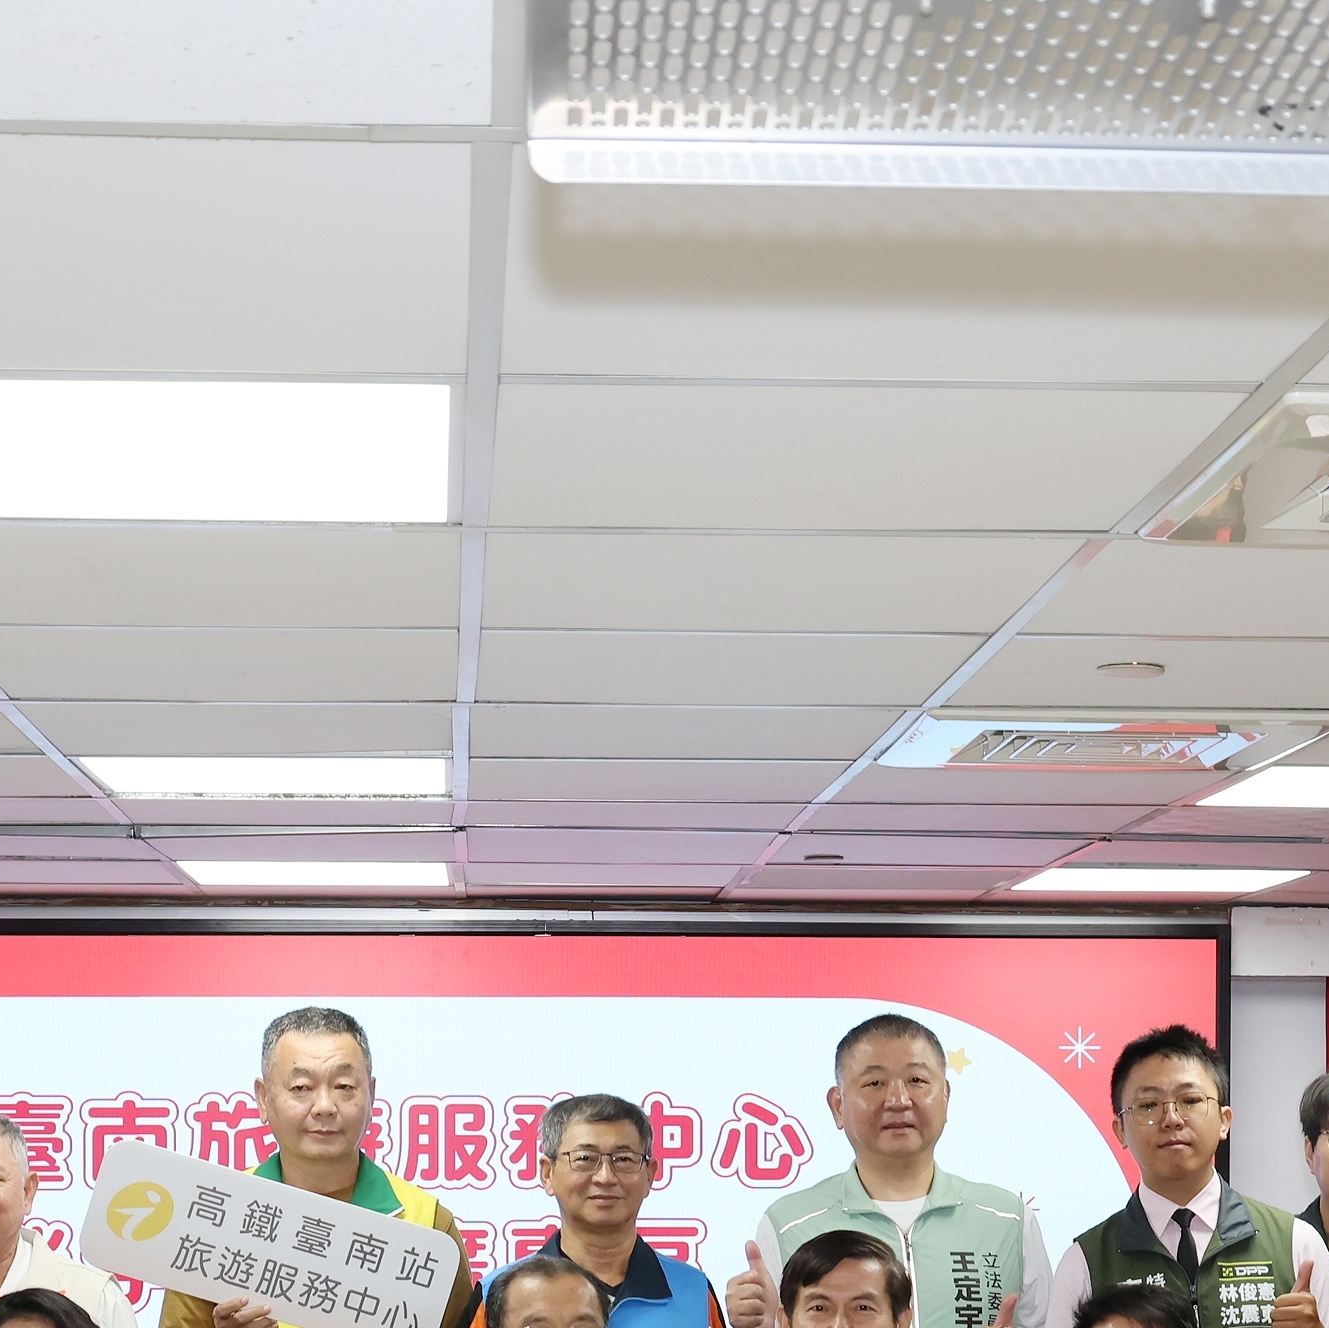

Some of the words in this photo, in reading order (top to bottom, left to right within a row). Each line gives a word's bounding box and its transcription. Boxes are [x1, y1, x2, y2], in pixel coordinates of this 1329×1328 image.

[186, 1185, 441, 1290] 高鐵臺南站
[1234, 1265, 1270, 1276] DPP
[1218, 1281, 1277, 1304] 林俊憲
